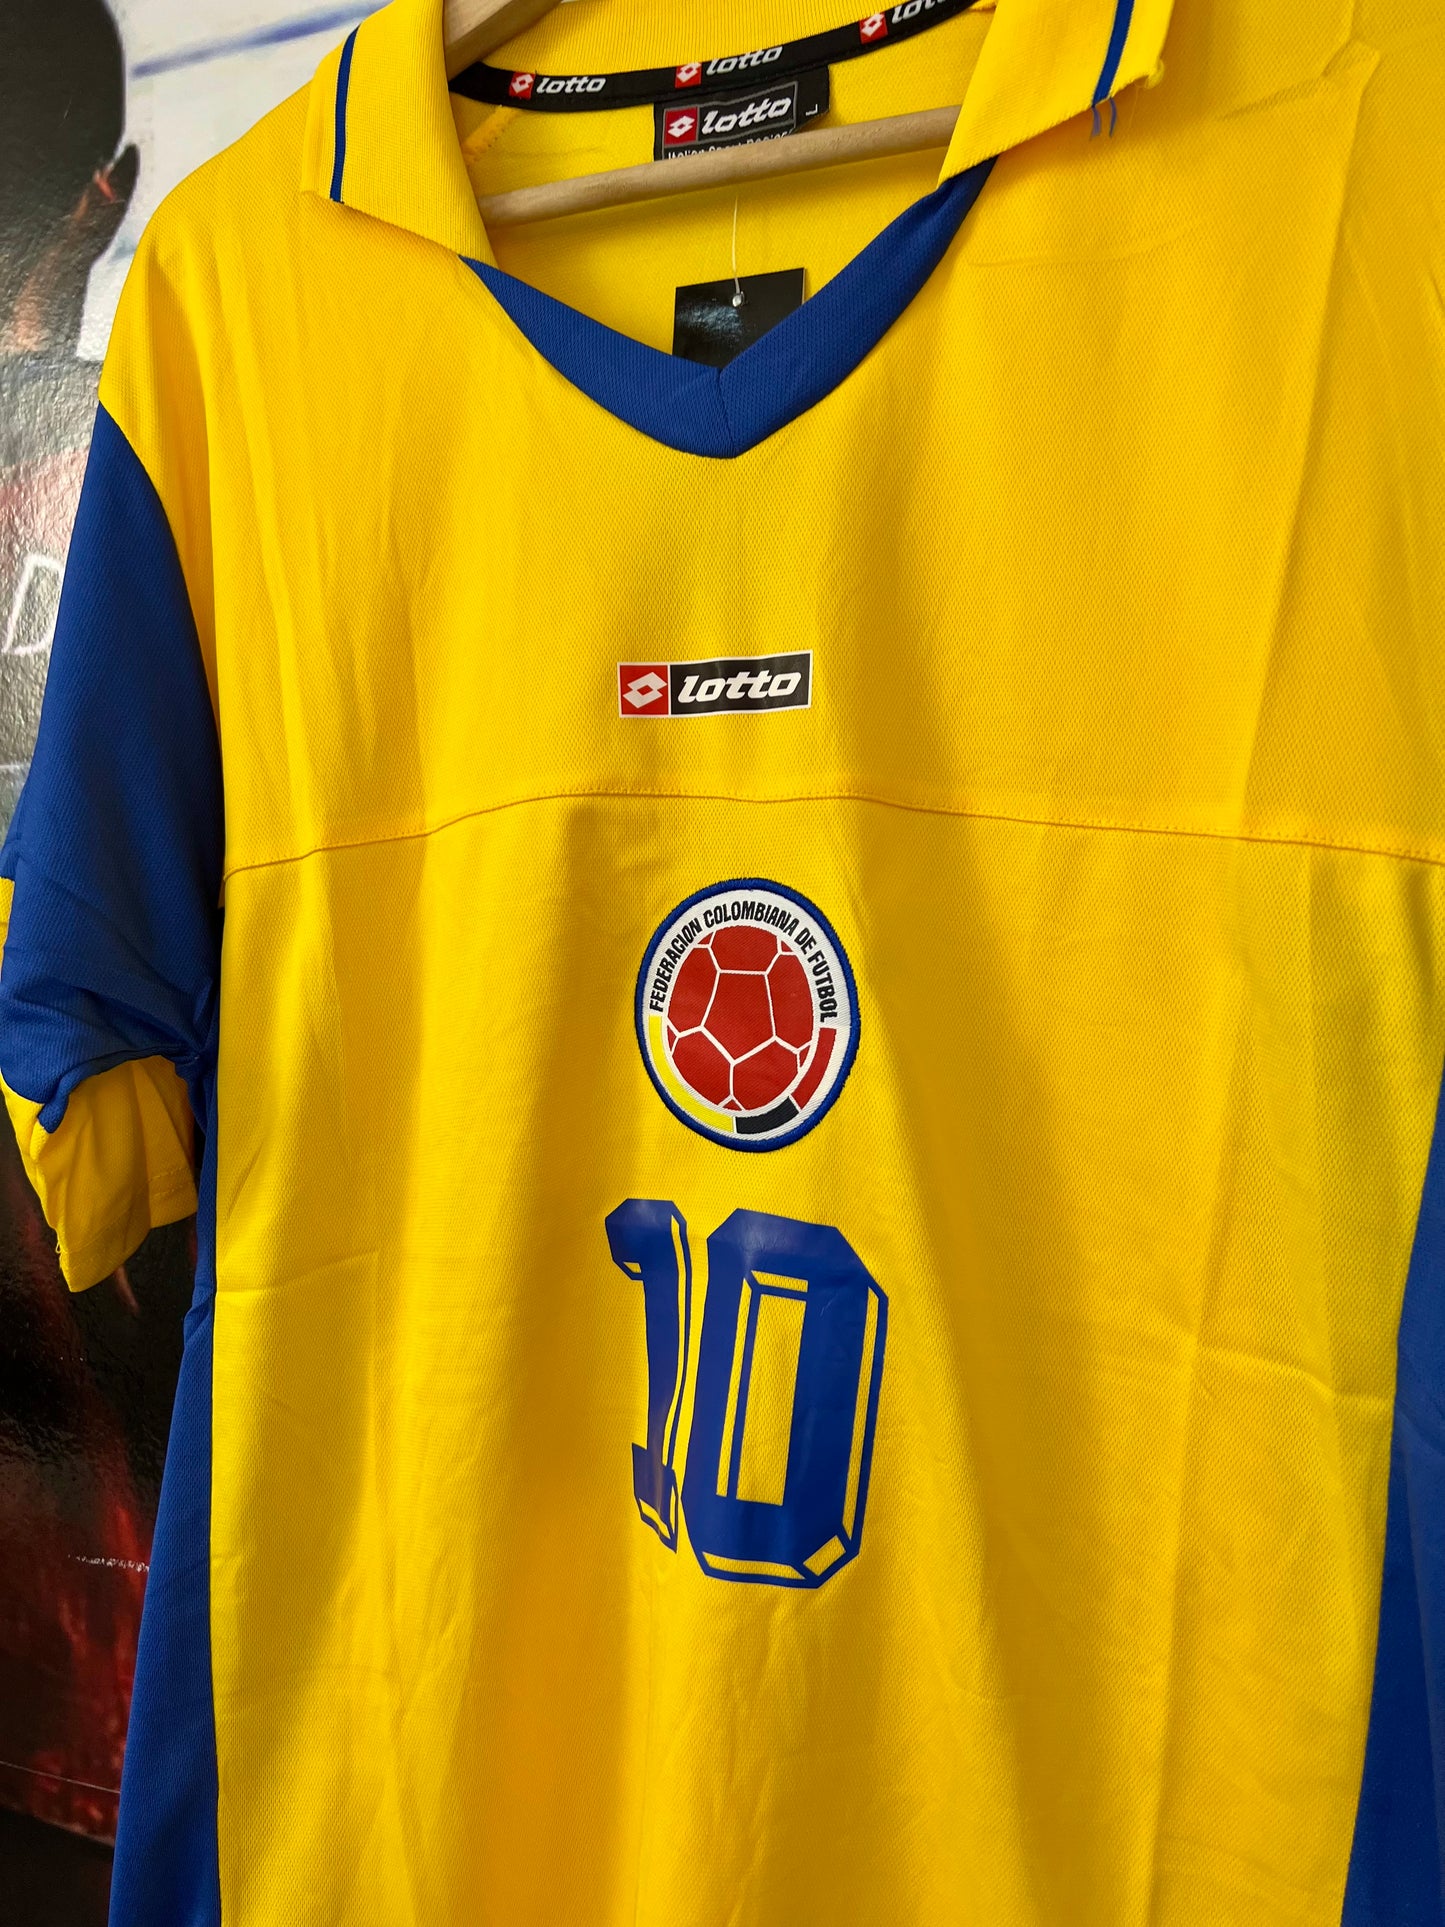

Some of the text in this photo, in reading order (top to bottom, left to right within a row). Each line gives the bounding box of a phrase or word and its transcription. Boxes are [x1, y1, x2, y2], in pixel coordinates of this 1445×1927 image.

[892, 0, 945, 24] lot
[706, 46, 783, 75] lotto
[536, 76, 606, 94] lotto
[701, 97, 791, 135] lotto
[678, 670, 801, 704] lotto
[649, 900, 838, 1023] FEDERACION COLOMBIANA DE FUTBOL
[605, 1198, 889, 1590] 10
